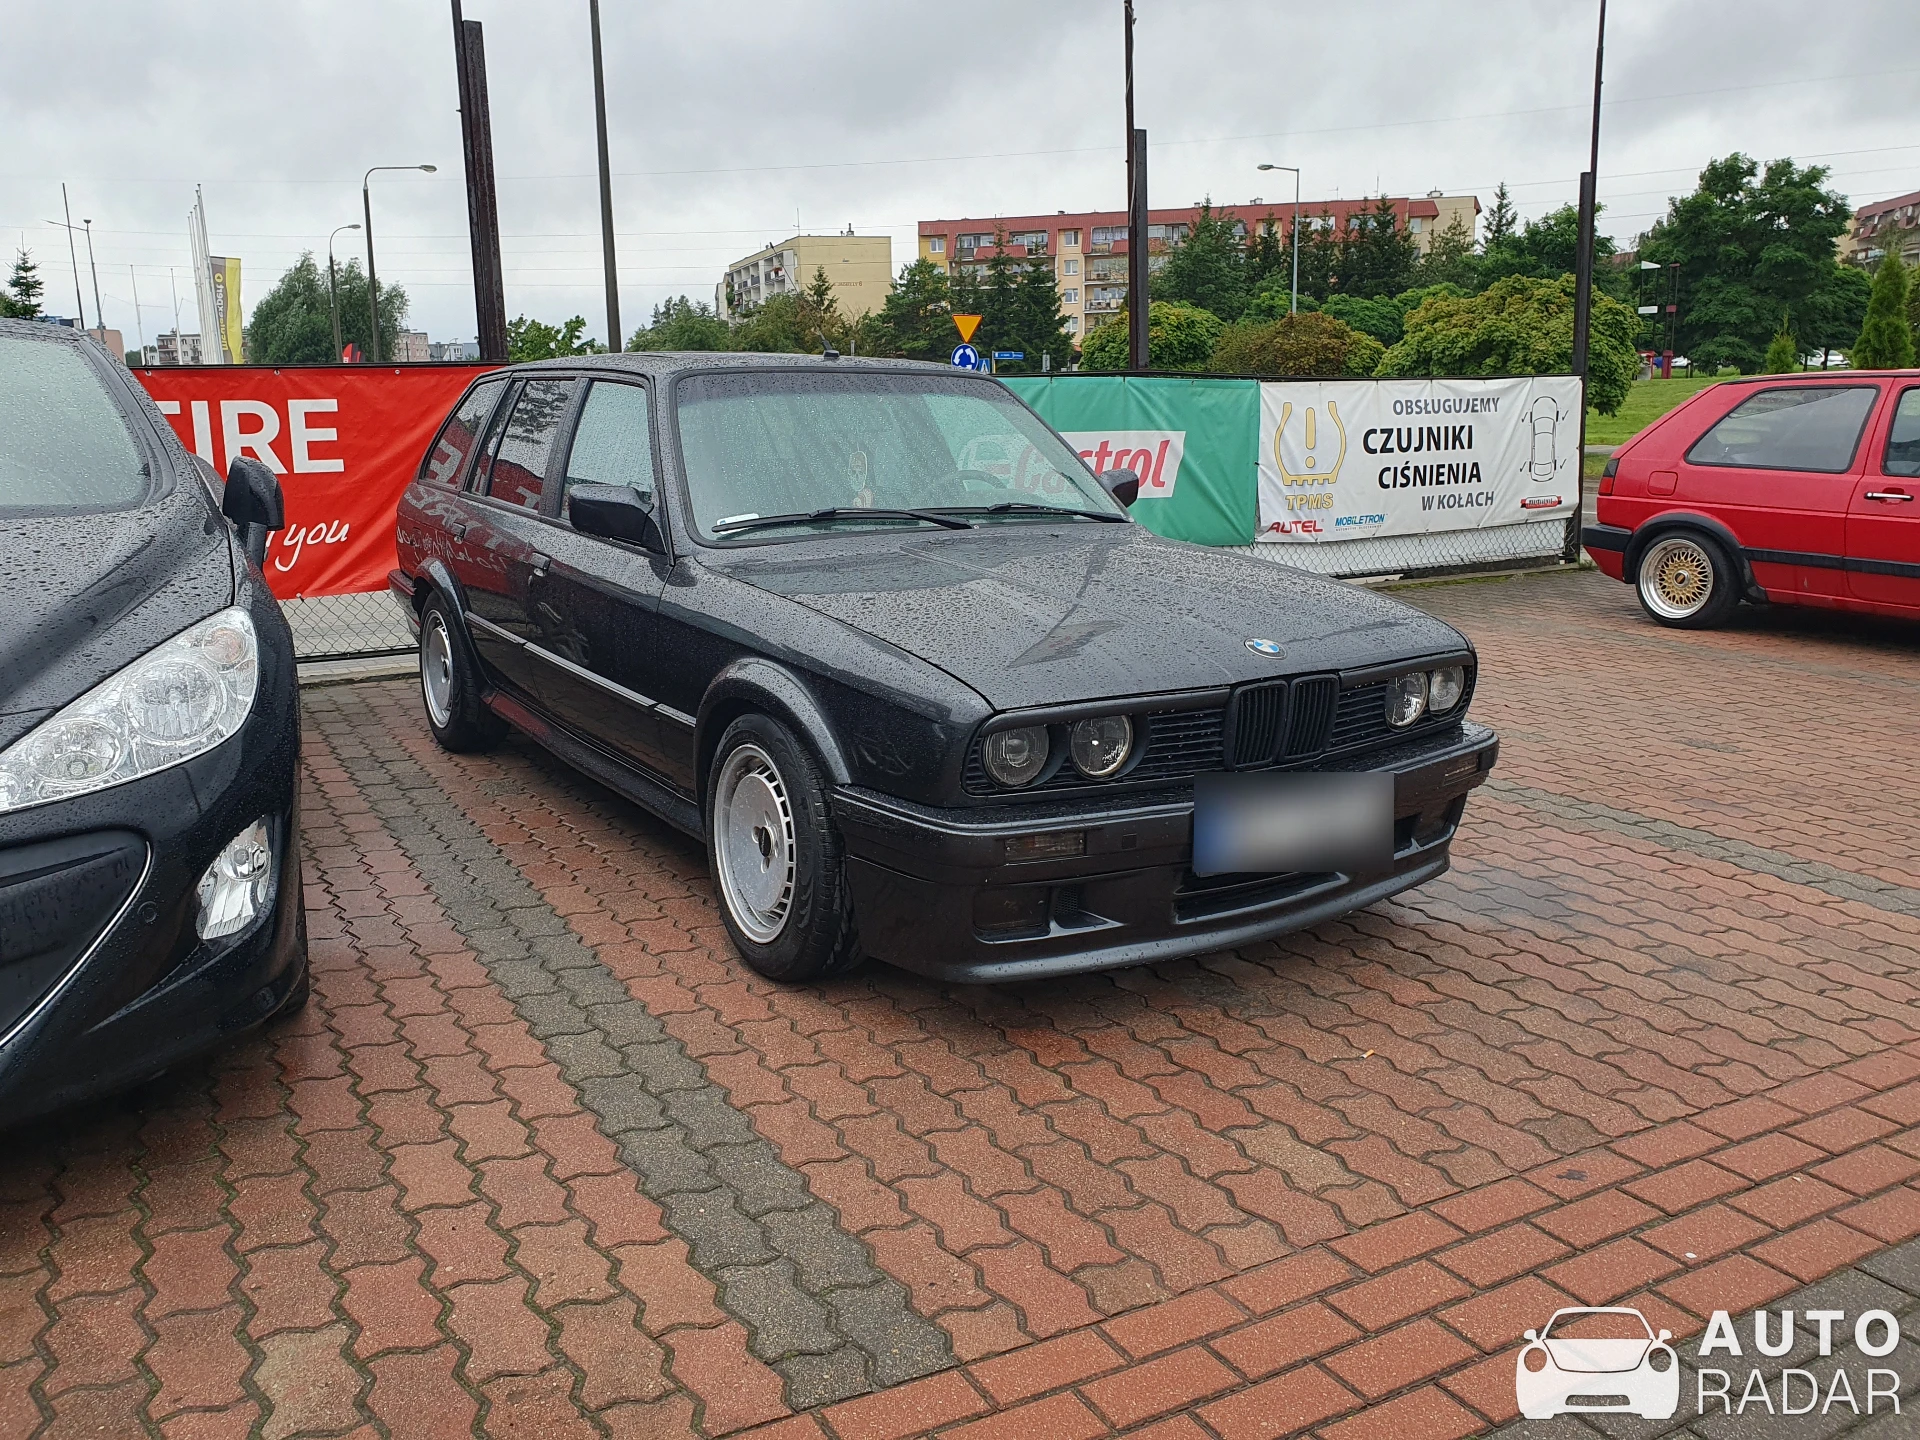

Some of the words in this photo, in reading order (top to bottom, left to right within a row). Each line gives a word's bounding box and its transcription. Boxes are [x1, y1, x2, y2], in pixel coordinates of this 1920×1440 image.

[1392, 397, 1500, 416] OBSŁUGUJEMY
[1362, 424, 1473, 455] CZUJNIKI
[1378, 460, 1482, 490] CIŚNIENIA
[1285, 492, 1334, 511] TPMS
[1421, 495, 1435, 511] W
[1437, 490, 1495, 510] KOŁACH
[1266, 520, 1323, 534] AUTEL
[274, 519, 350, 572] you
